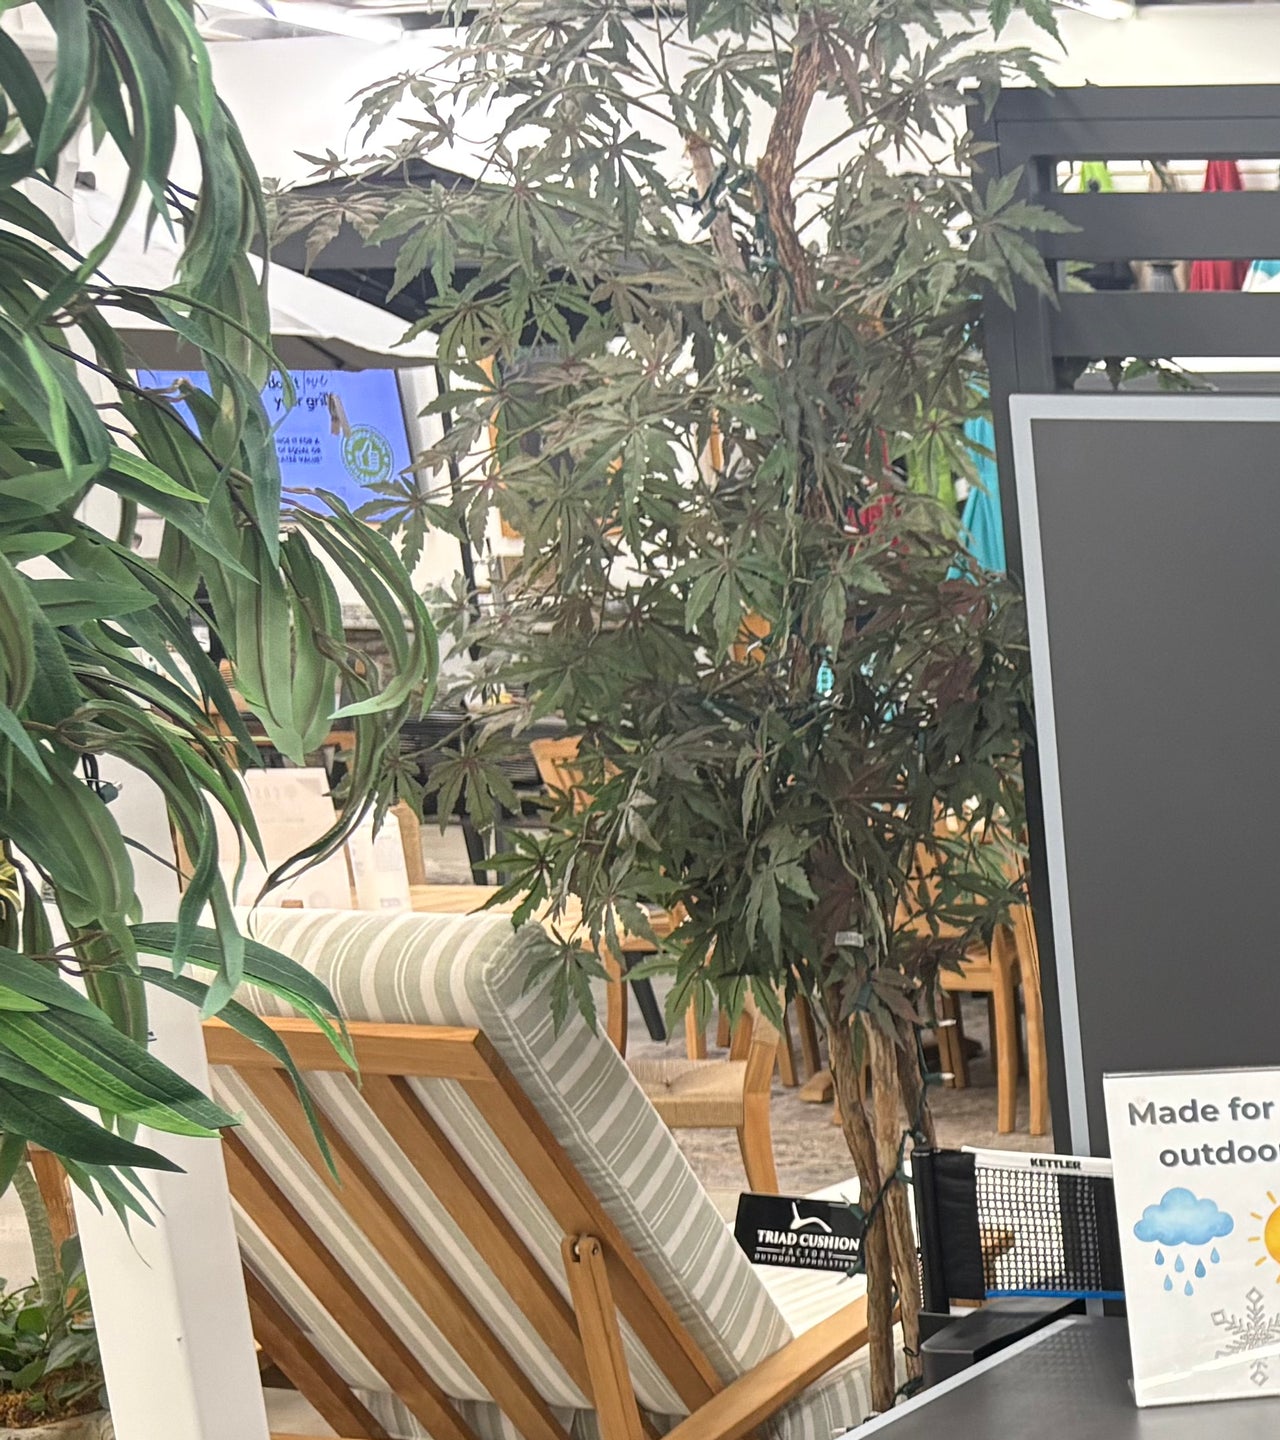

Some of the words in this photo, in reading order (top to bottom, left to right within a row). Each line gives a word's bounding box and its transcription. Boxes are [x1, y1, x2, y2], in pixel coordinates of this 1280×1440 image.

[1128, 1098, 1219, 1126] Made
[1228, 1097, 1275, 1121] for
[1030, 1158, 1081, 1170] KETTLER
[757, 1229, 798, 1246] TRIAD
[799, 1233, 861, 1251] CUSHION
[754, 1253, 796, 1264] OUTDOOR
[781, 1246, 833, 1259] FACTORY
